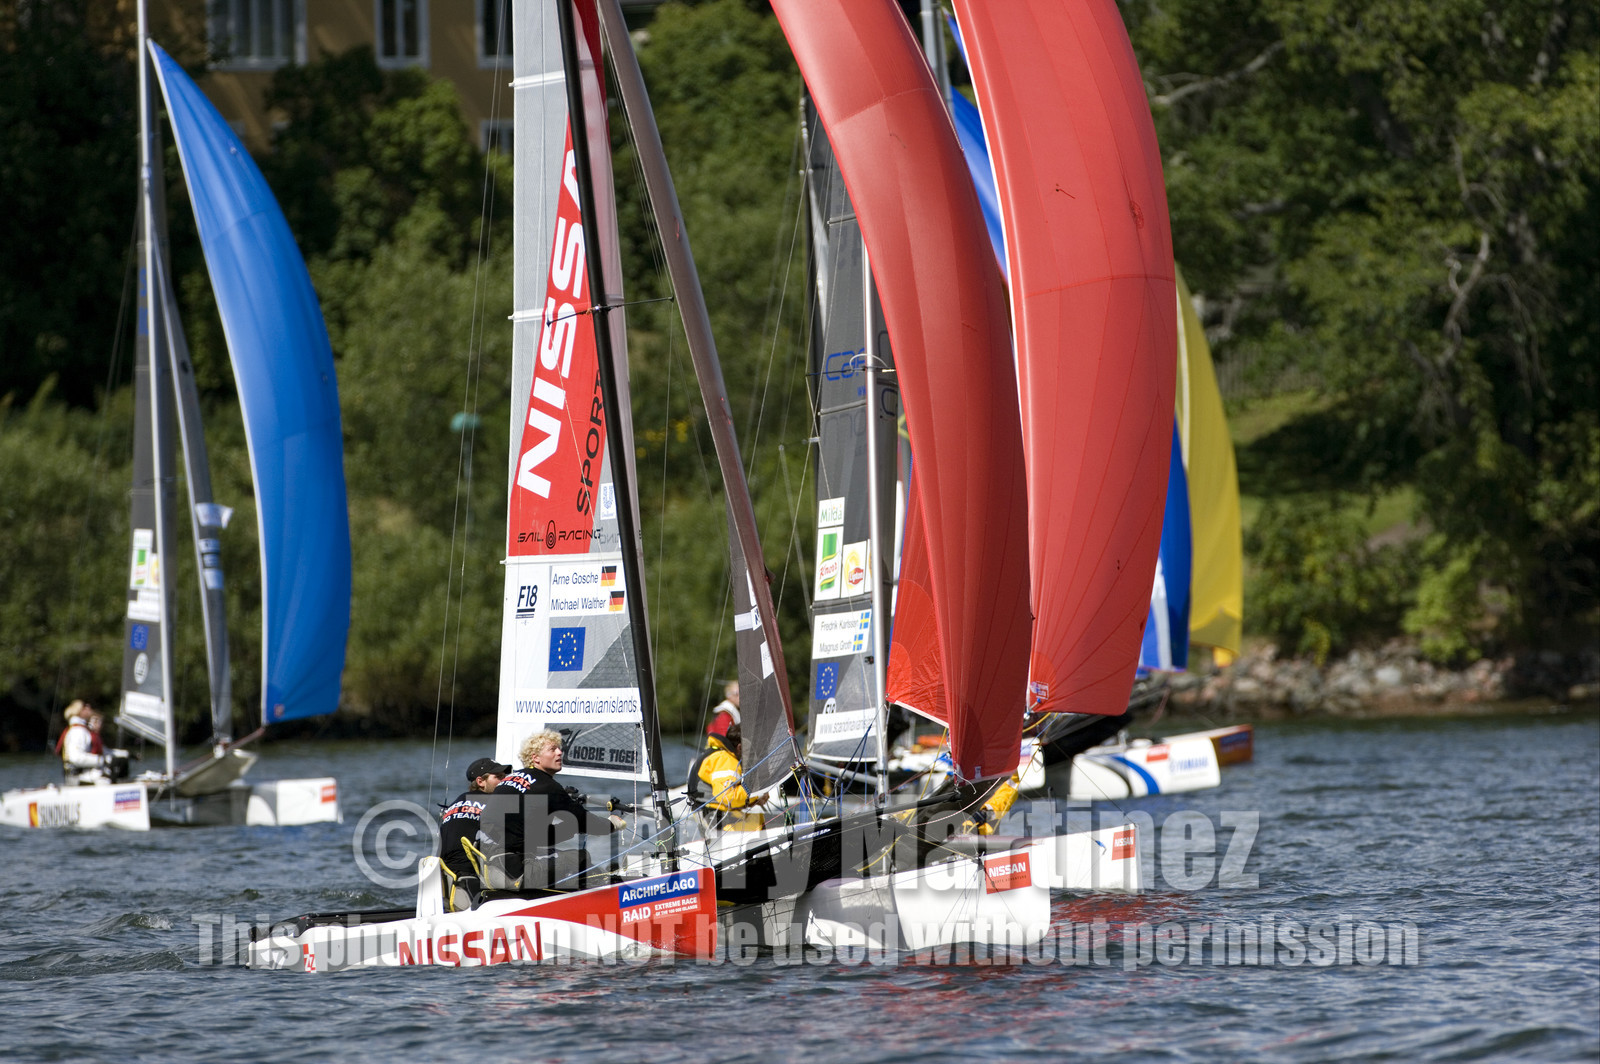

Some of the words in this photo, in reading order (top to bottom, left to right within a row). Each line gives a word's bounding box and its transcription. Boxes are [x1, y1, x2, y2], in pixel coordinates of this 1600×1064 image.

[552, 573, 570, 585] Arne
[571, 572, 599, 585] Gosche
[517, 585, 538, 607] F18
[550, 598, 580, 611] Michael
[581, 593, 607, 610] Walther
[573, 746, 605, 761] HOBIE
[609, 749, 638, 764] TIGER
[453, 812, 481, 821] TEAM
[1114, 836, 1134, 847] NISSAN
[988, 861, 1027, 878] NISSAN
[622, 877, 696, 903] ARCHIPELAGO
[654, 900, 681, 911] EXTREME
[681, 897, 698, 906] RACE
[622, 906, 652, 923] RAID
[398, 921, 544, 967] NISSAN
